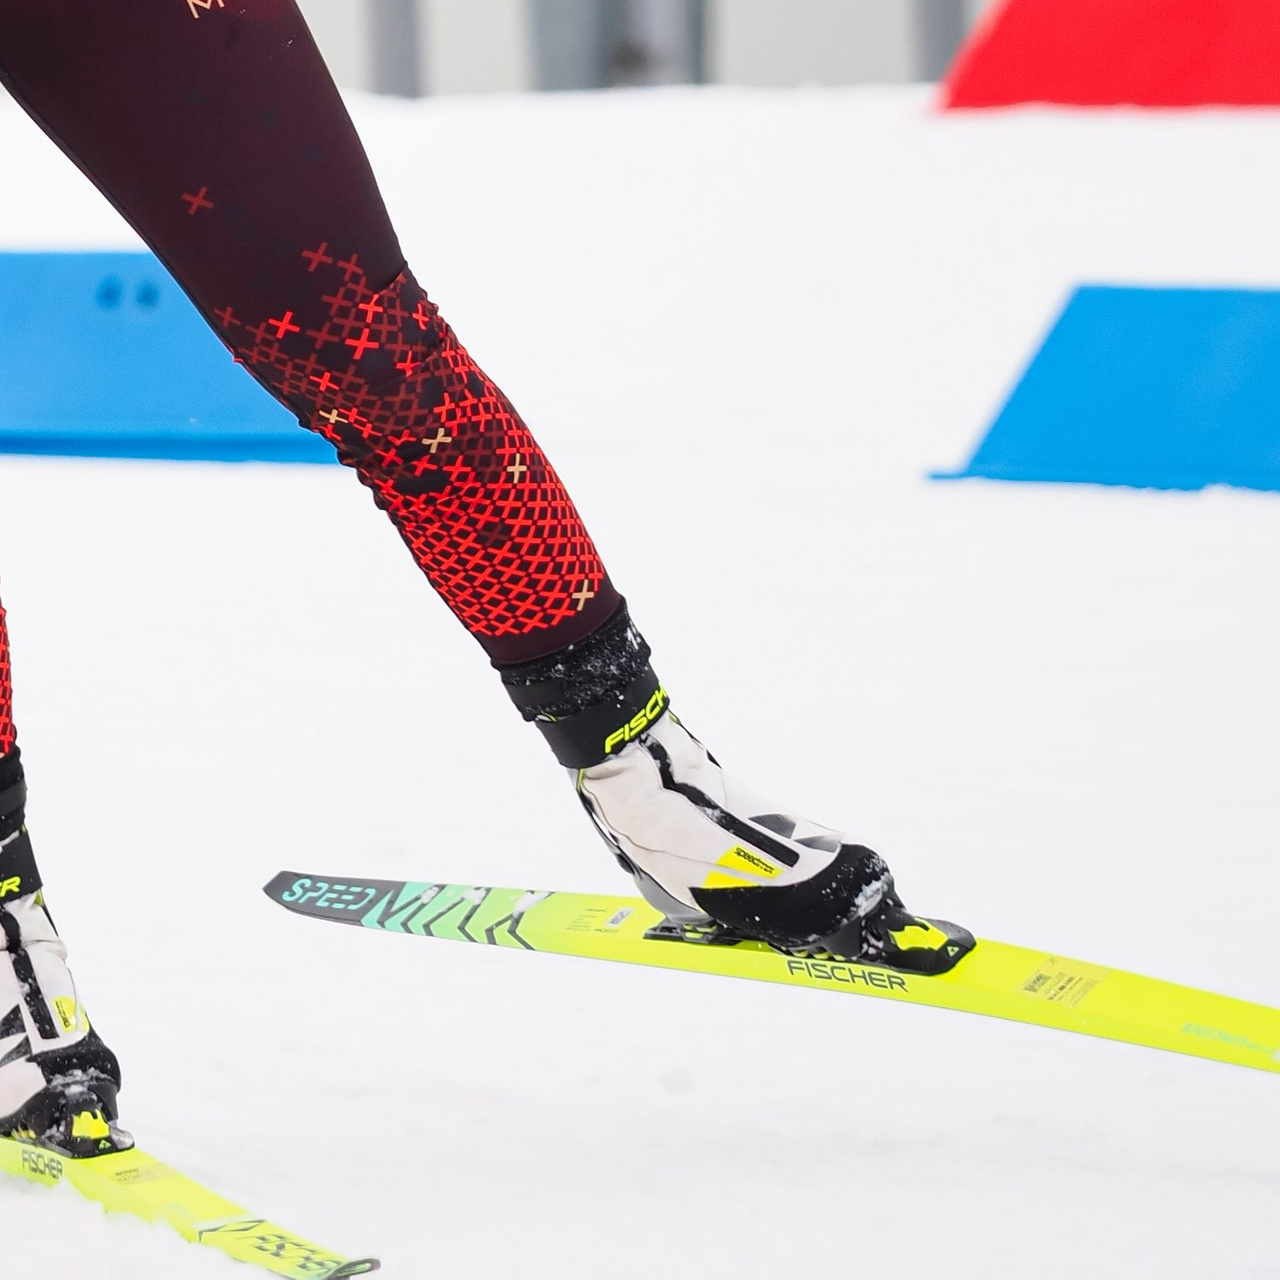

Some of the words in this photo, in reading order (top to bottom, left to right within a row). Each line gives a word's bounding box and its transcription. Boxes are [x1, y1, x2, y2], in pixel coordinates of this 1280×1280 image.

[604, 682, 668, 754] FISCH
[787, 959, 909, 993] FISCHER
[21, 1148, 63, 1180] FISCHER
